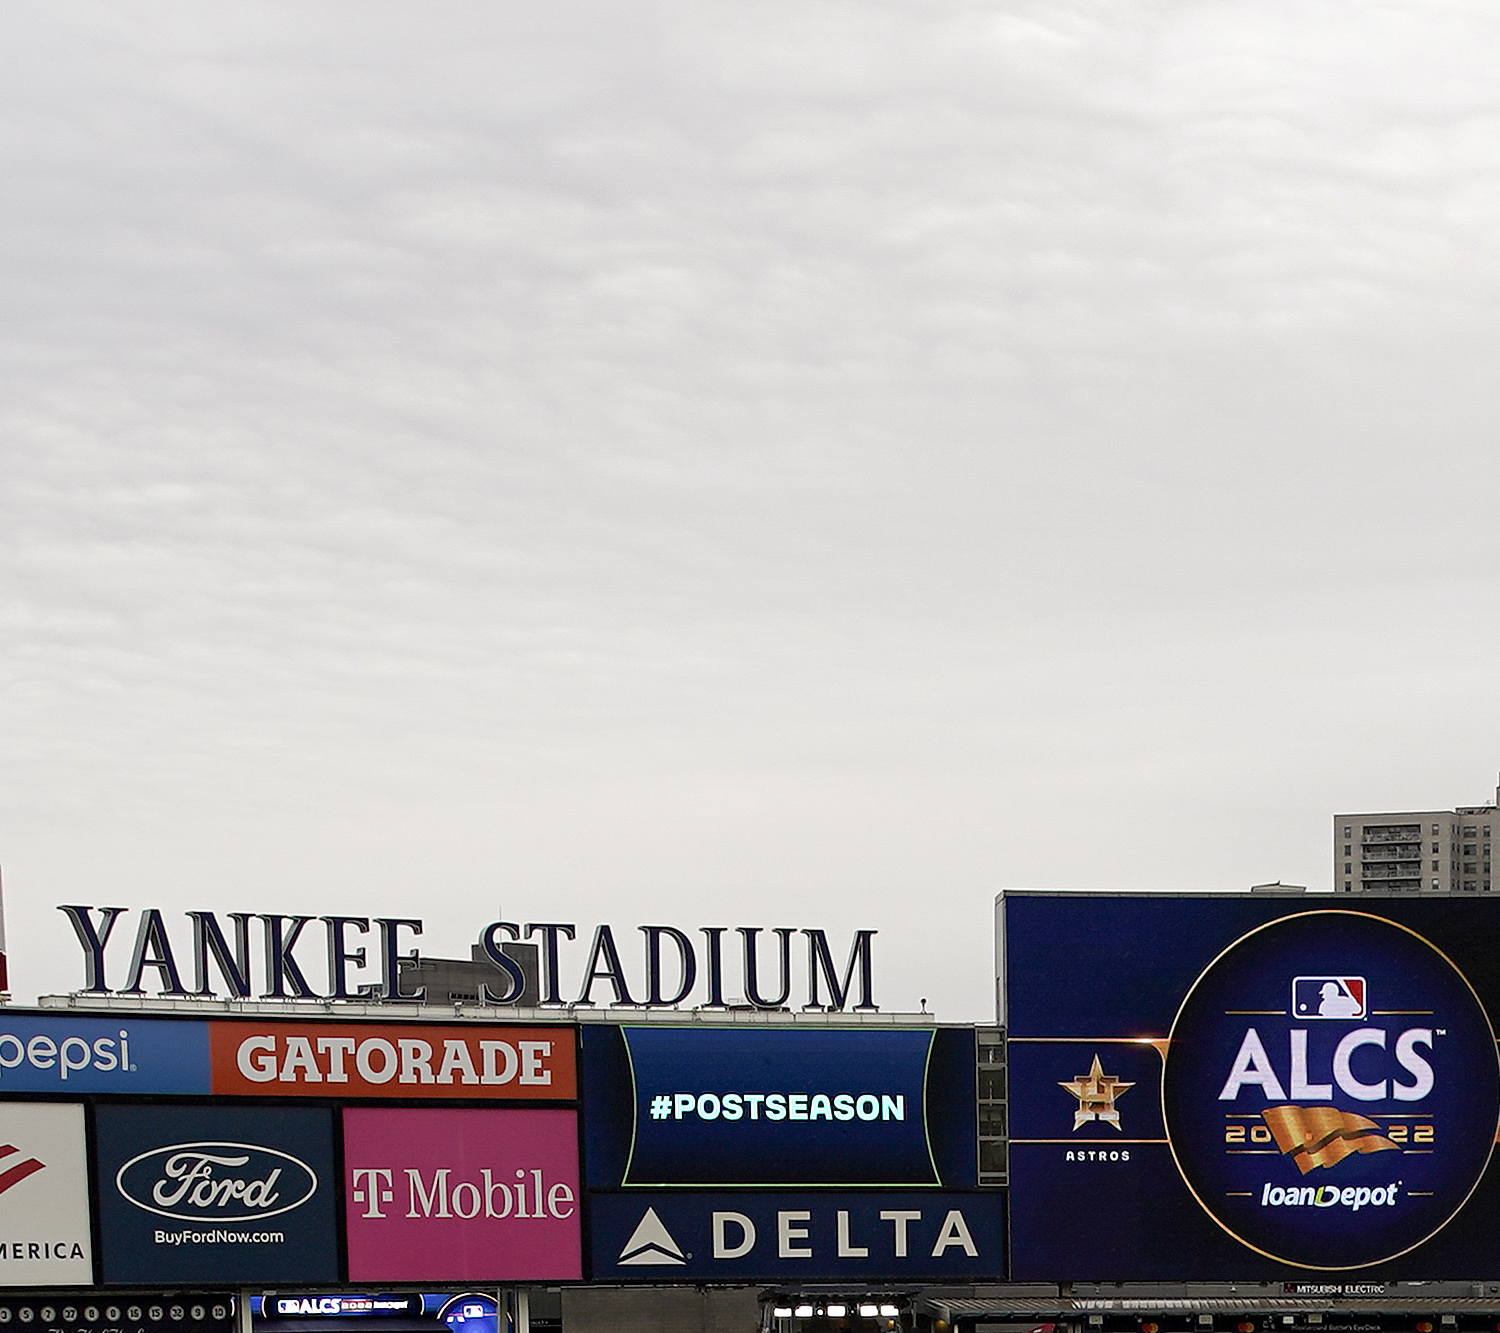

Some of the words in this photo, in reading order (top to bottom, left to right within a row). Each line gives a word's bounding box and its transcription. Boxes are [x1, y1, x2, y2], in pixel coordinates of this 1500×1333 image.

[57, 905, 428, 1004] YANKEE
[479, 920, 878, 1012] STADIUM
[237, 1036, 552, 1086] GATORADE
[1219, 1028, 1436, 1101] ALCS
[650, 1093, 905, 1121] #POSTSEASON
[1066, 1151, 1131, 1161] ASTROS
[153, 1151, 281, 1208] Ford
[1262, 1182, 1398, 1211] loanDepot
[154, 1229, 284, 1246] BuyFordNow.com
[712, 1210, 979, 1259] DELTA
[1297, 1284, 1341, 1294] MITSUBISHI
[1344, 1284, 1385, 1294] ELECTRIC
[299, 1299, 340, 1314] ALCS
